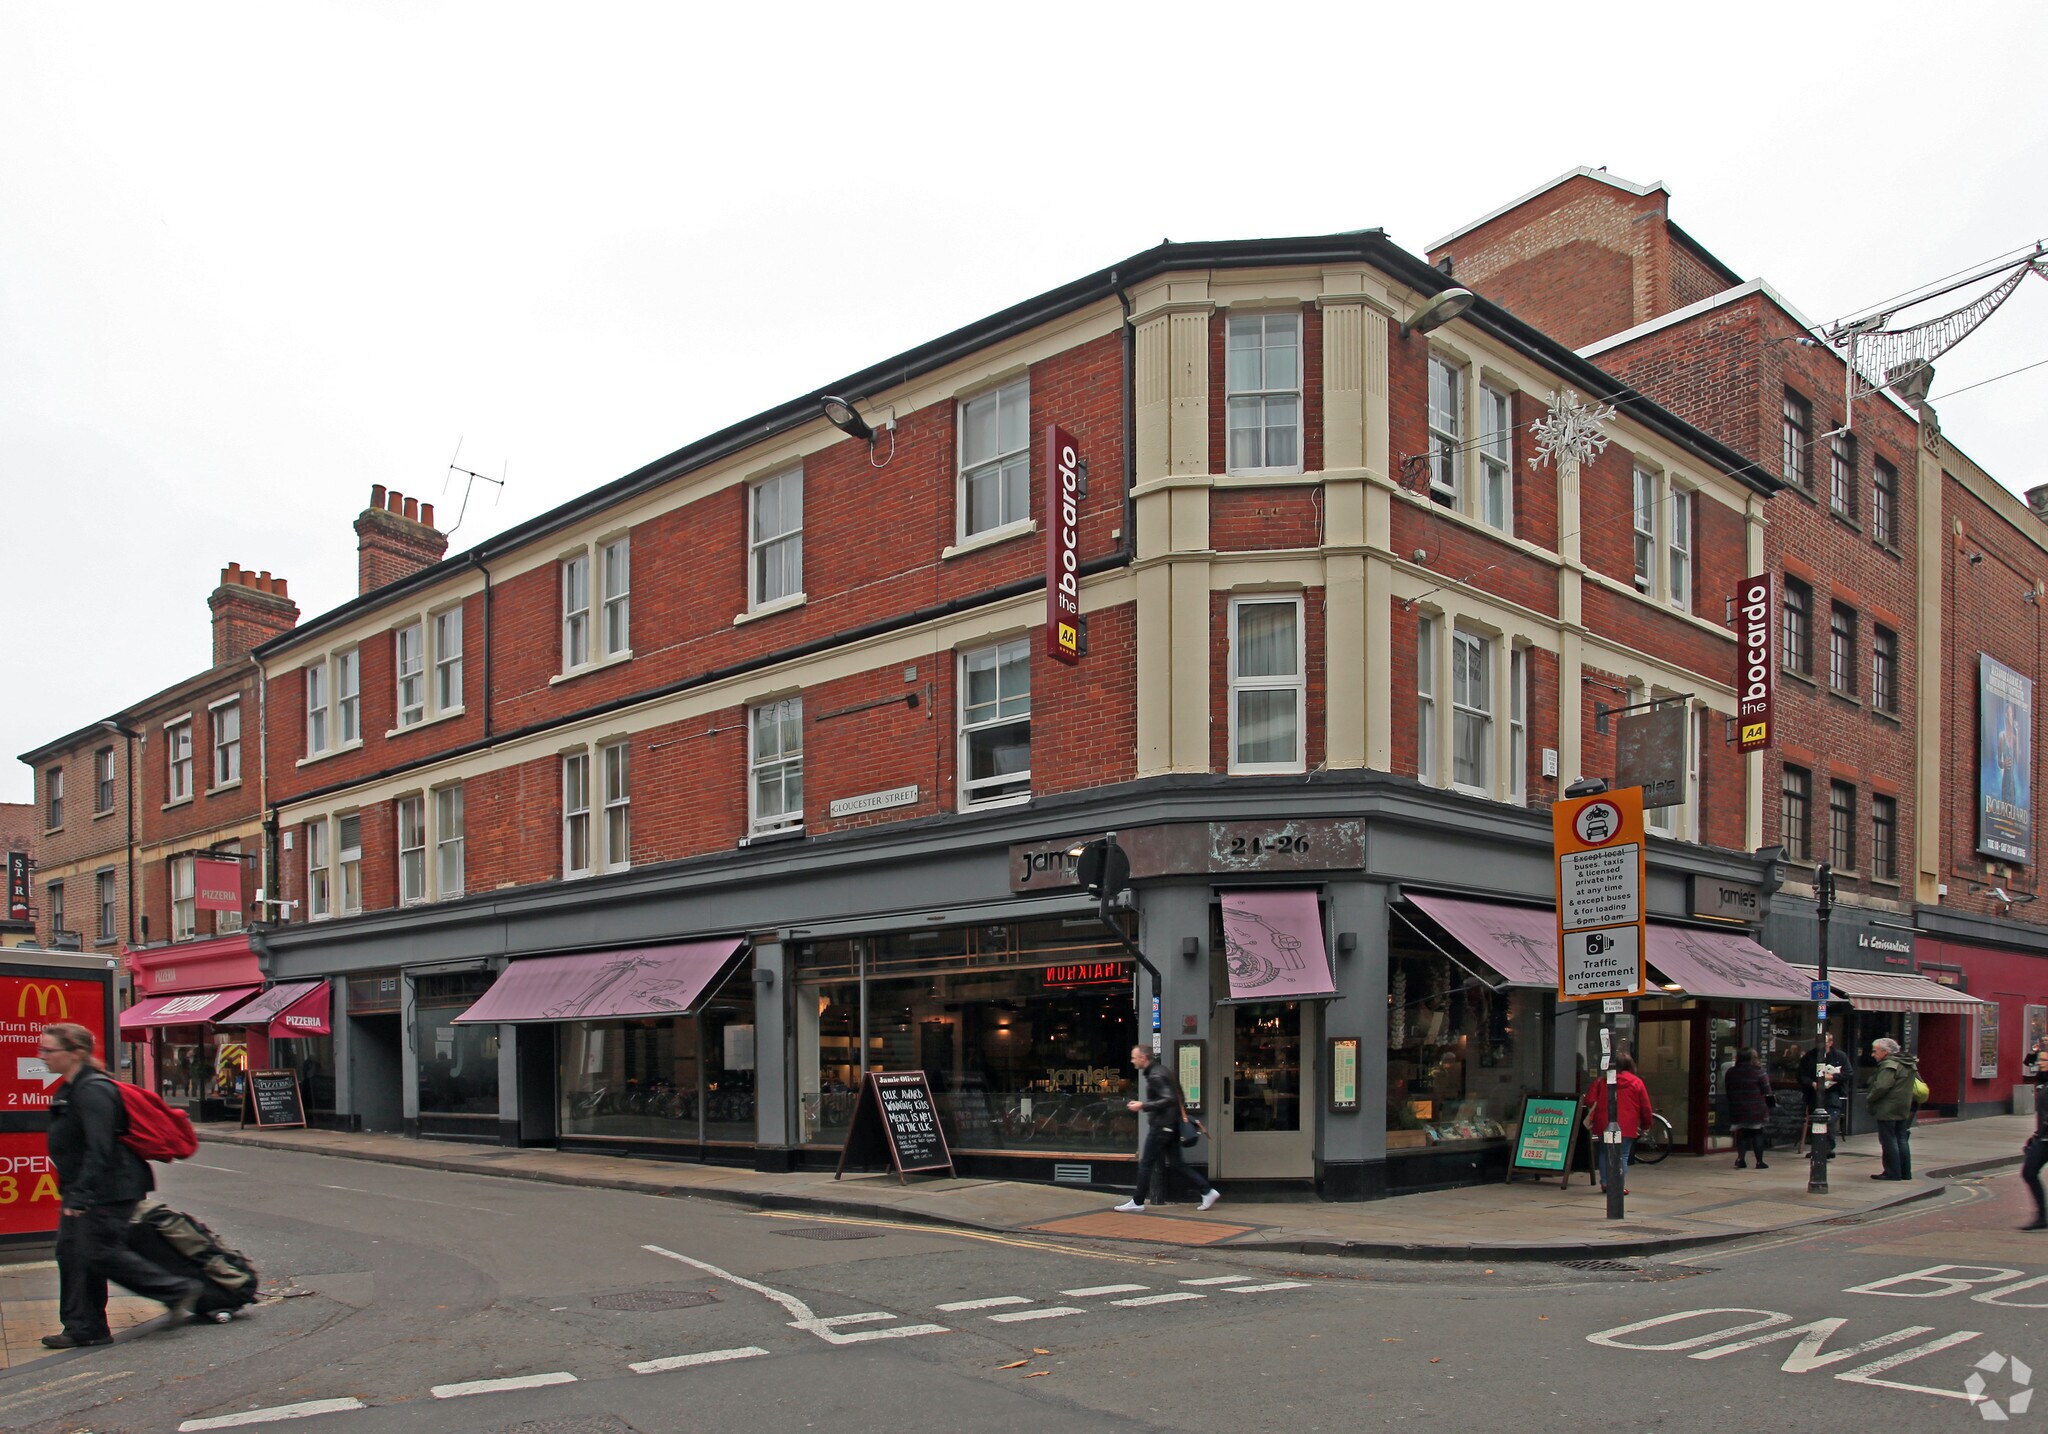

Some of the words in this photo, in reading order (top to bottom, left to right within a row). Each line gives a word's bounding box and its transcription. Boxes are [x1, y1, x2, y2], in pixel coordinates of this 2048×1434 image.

[1058, 446, 1077, 597] bocardo
[1058, 592, 1077, 614] the
[1061, 626, 1074, 644] AA
[1741, 585, 1767, 702] bocardo
[1741, 702, 1767, 715] the
[1745, 726, 1763, 739] AA
[833, 796, 882, 813] GLOUCESTER
[885, 790, 915, 804] STREET
[1231, 835, 1310, 856] 24-26
[1573, 852, 1602, 863] Except
[1604, 848, 1625, 858] local
[1604, 858, 1624, 866] taxis
[1586, 866, 1620, 877] licensed
[1575, 877, 1604, 887] private
[1606, 874, 1623, 882] hire
[1604, 884, 1623, 892] time
[201, 889, 236, 901] PIZZERIA
[1577, 896, 1604, 906] except
[1606, 893, 1631, 901] buses
[1596, 903, 1626, 913] loading
[1859, 933, 1868, 947] La
[1583, 958, 1617, 968] Traffic
[154, 967, 177, 982] PIZZERIA
[1568, 966, 1634, 980] enforcement
[1577, 979, 1621, 990] cameras
[0, 1021, 26, 1031] Turn
[285, 1015, 321, 1027] PIZZERIA
[1708, 1018, 1718, 1096] bocardo
[8, 1092, 18, 1105] 2
[882, 1090, 898, 1100] OUR
[901, 1089, 923, 1099] AWARD
[884, 1101, 914, 1113] WINNING
[914, 1100, 929, 1110] KIDS
[889, 1112, 909, 1123] MENU
[910, 1110, 919, 1123] IS
[1528, 1115, 1569, 1125] CHRISTMAS
[896, 1122, 905, 1133] IN
[906, 1122, 919, 1133] THE
[1533, 1127, 1559, 1137] Jamie
